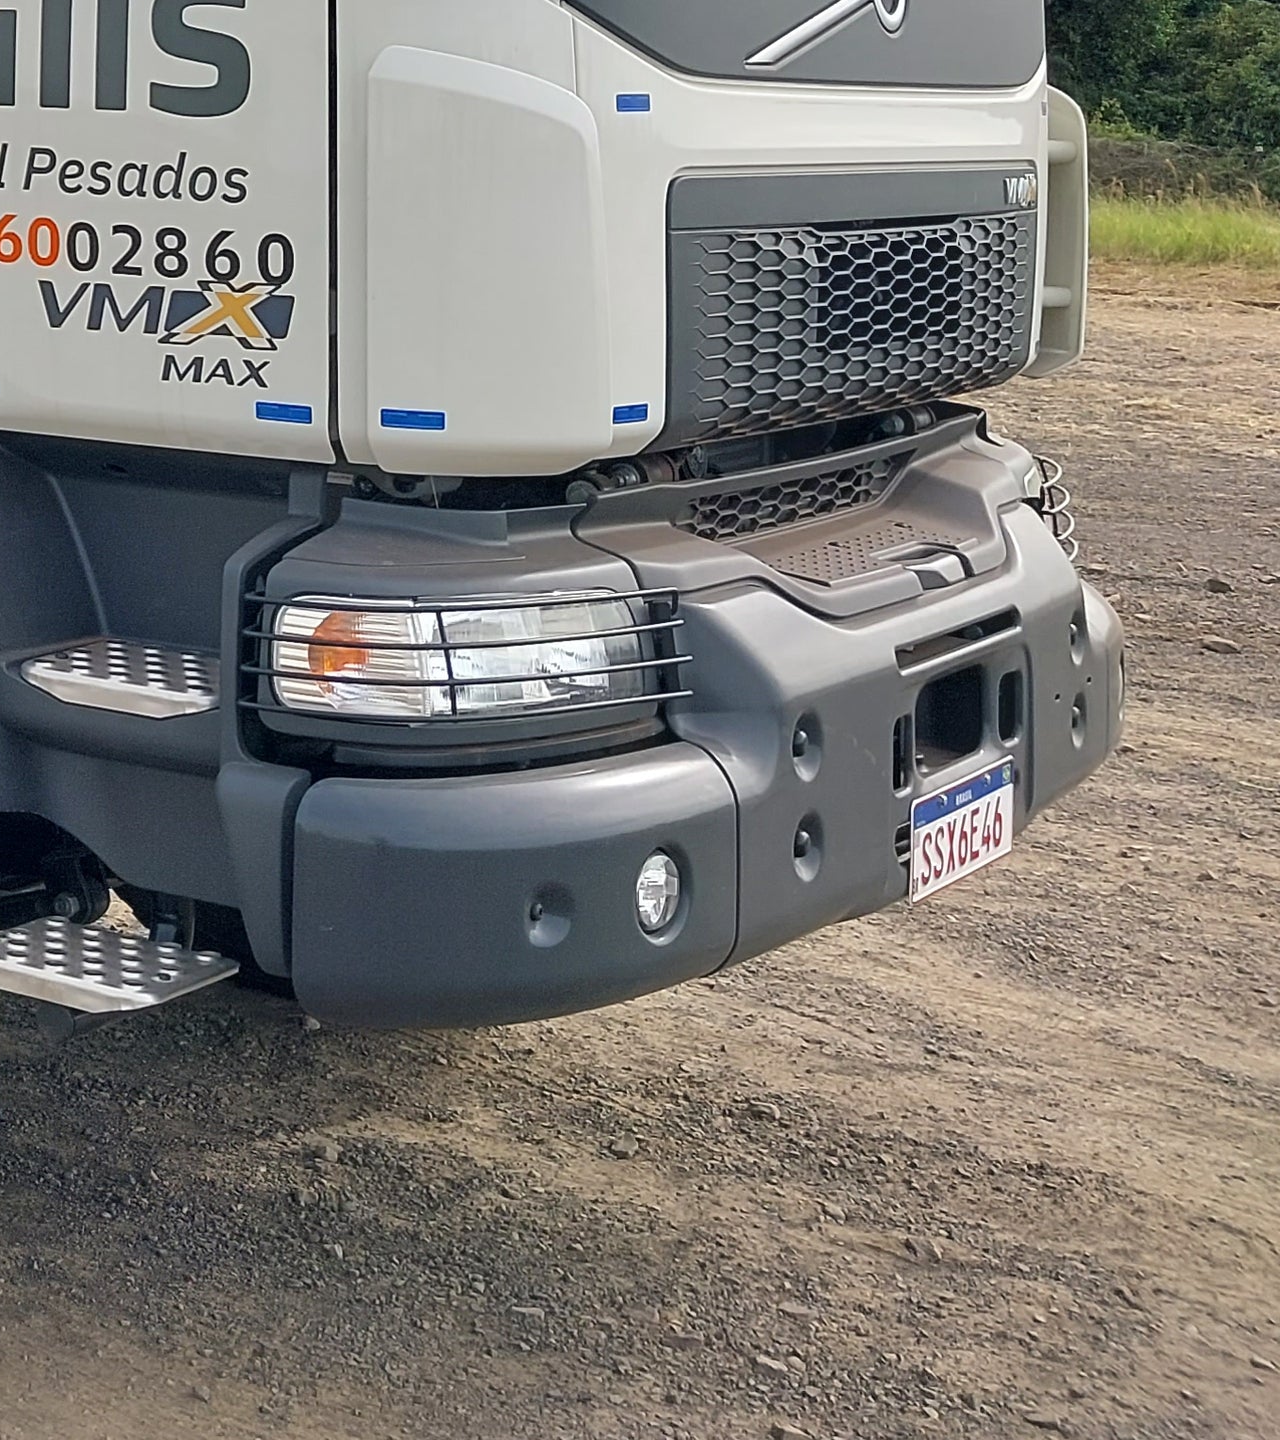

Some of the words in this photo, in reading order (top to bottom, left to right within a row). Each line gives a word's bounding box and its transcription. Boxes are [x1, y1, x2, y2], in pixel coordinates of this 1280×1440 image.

[22, 145, 250, 205] Pesados
[160, 355, 271, 388] MAX
[920, 795, 1004, 886] SSX6E46
